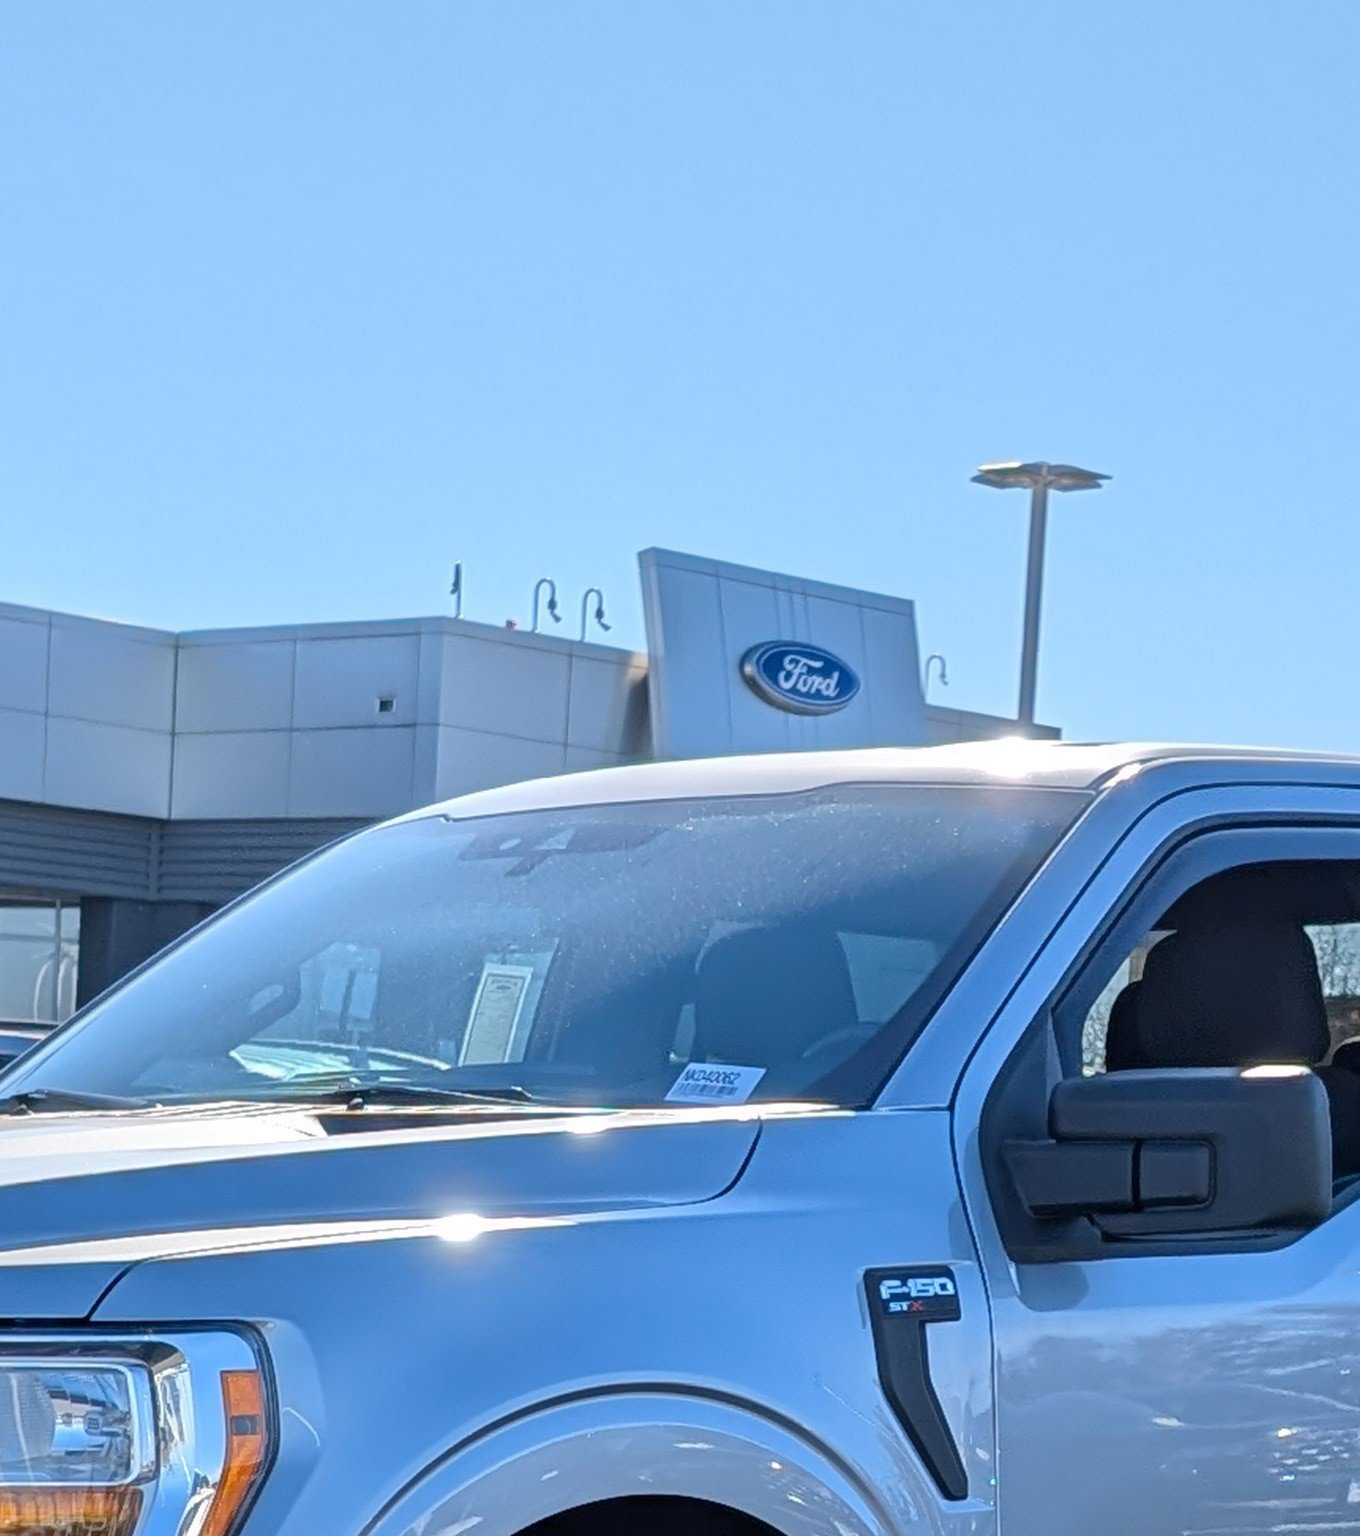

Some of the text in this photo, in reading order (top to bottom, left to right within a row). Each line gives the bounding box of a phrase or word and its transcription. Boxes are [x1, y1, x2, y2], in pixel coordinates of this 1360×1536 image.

[778, 654, 840, 697] Ford
[880, 1277, 955, 1299] F-150
[887, 1299, 924, 1313] STX
